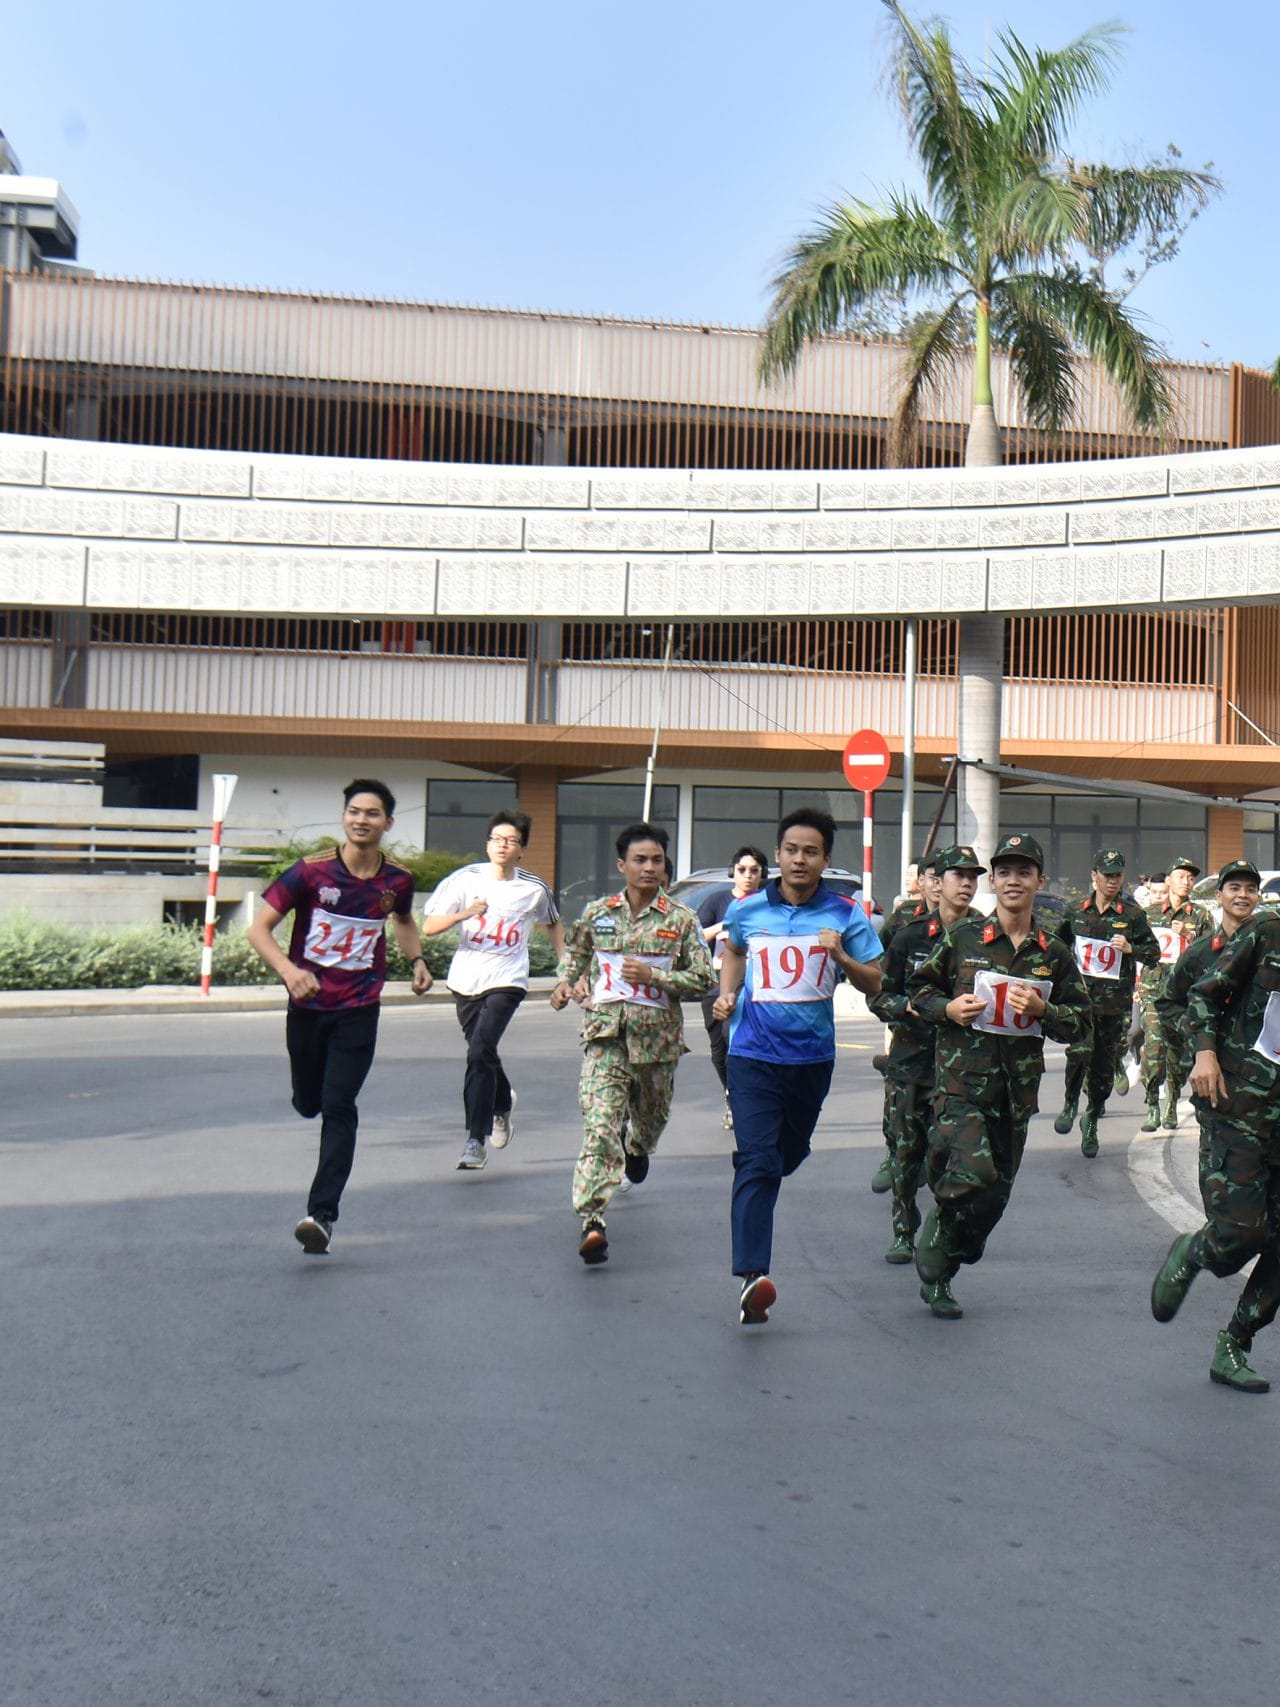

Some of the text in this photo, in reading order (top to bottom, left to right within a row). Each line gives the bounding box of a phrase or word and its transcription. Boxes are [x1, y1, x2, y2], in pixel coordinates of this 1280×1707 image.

[311, 921, 378, 960] 247
[471, 914, 521, 947] 246
[755, 944, 829, 989] 197
[1082, 943, 1116, 973] 19
